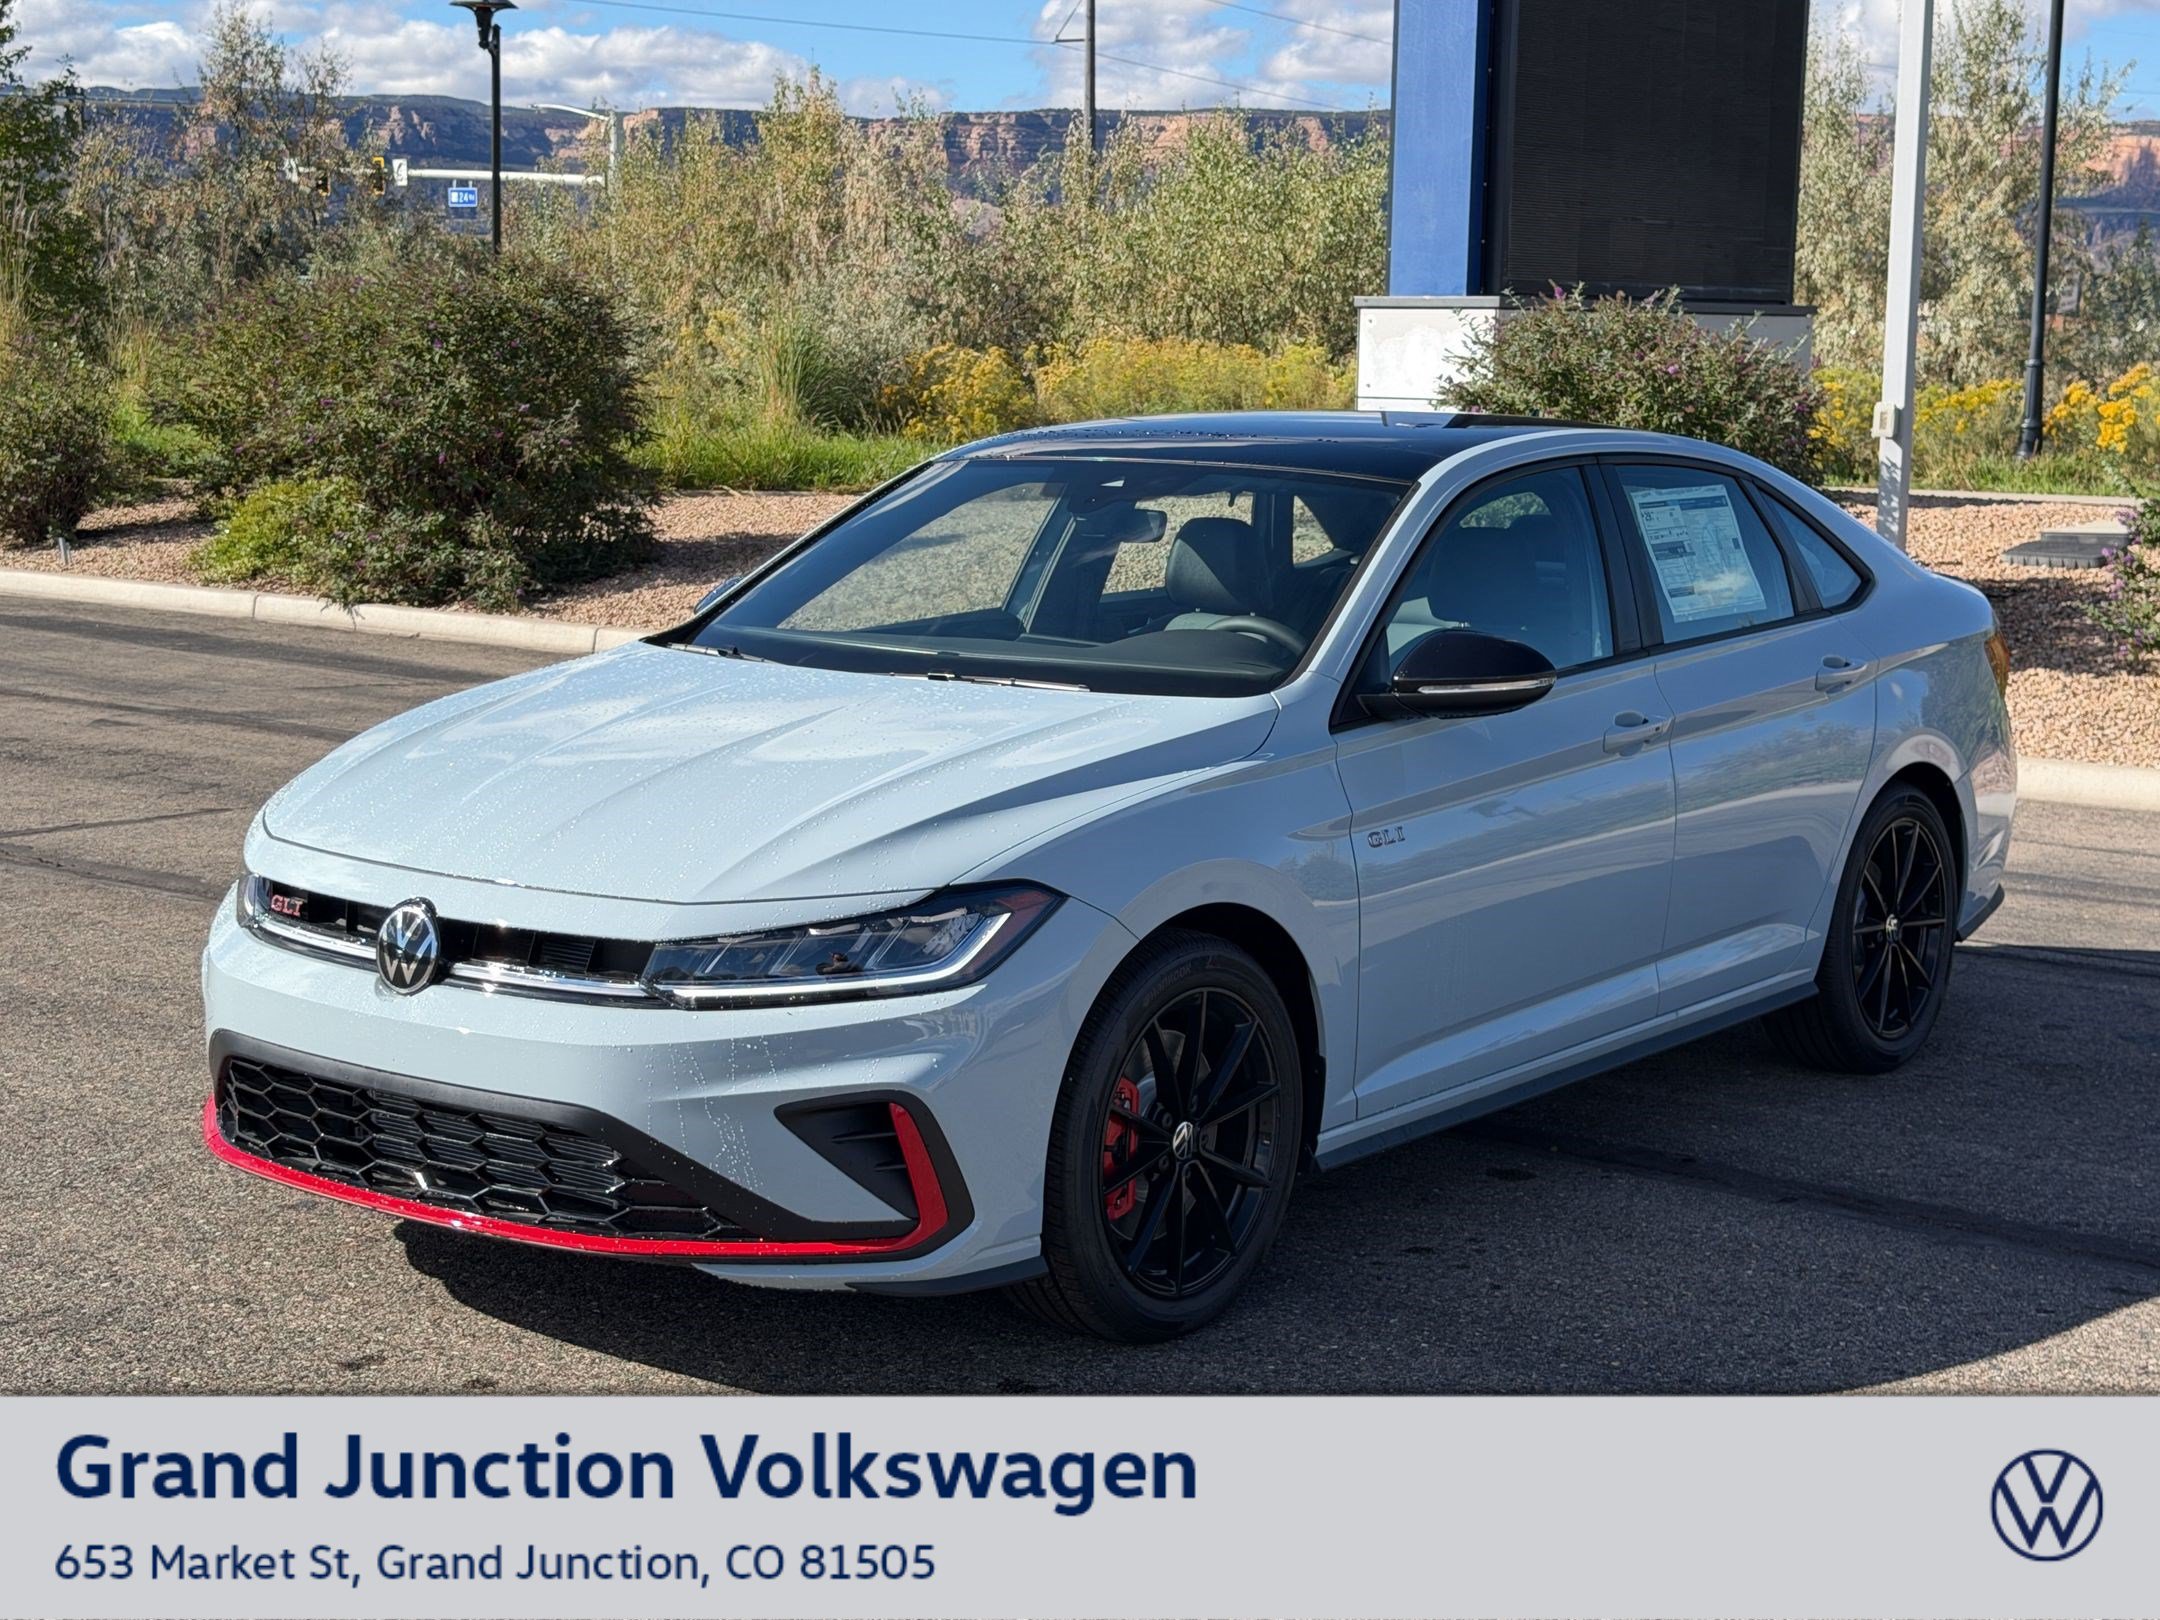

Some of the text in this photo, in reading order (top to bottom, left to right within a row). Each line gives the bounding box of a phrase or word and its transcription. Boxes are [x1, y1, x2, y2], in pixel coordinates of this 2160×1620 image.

[459, 191, 469, 203] 24
[1368, 826, 1406, 848] GLI
[271, 894, 303, 917] GLI
